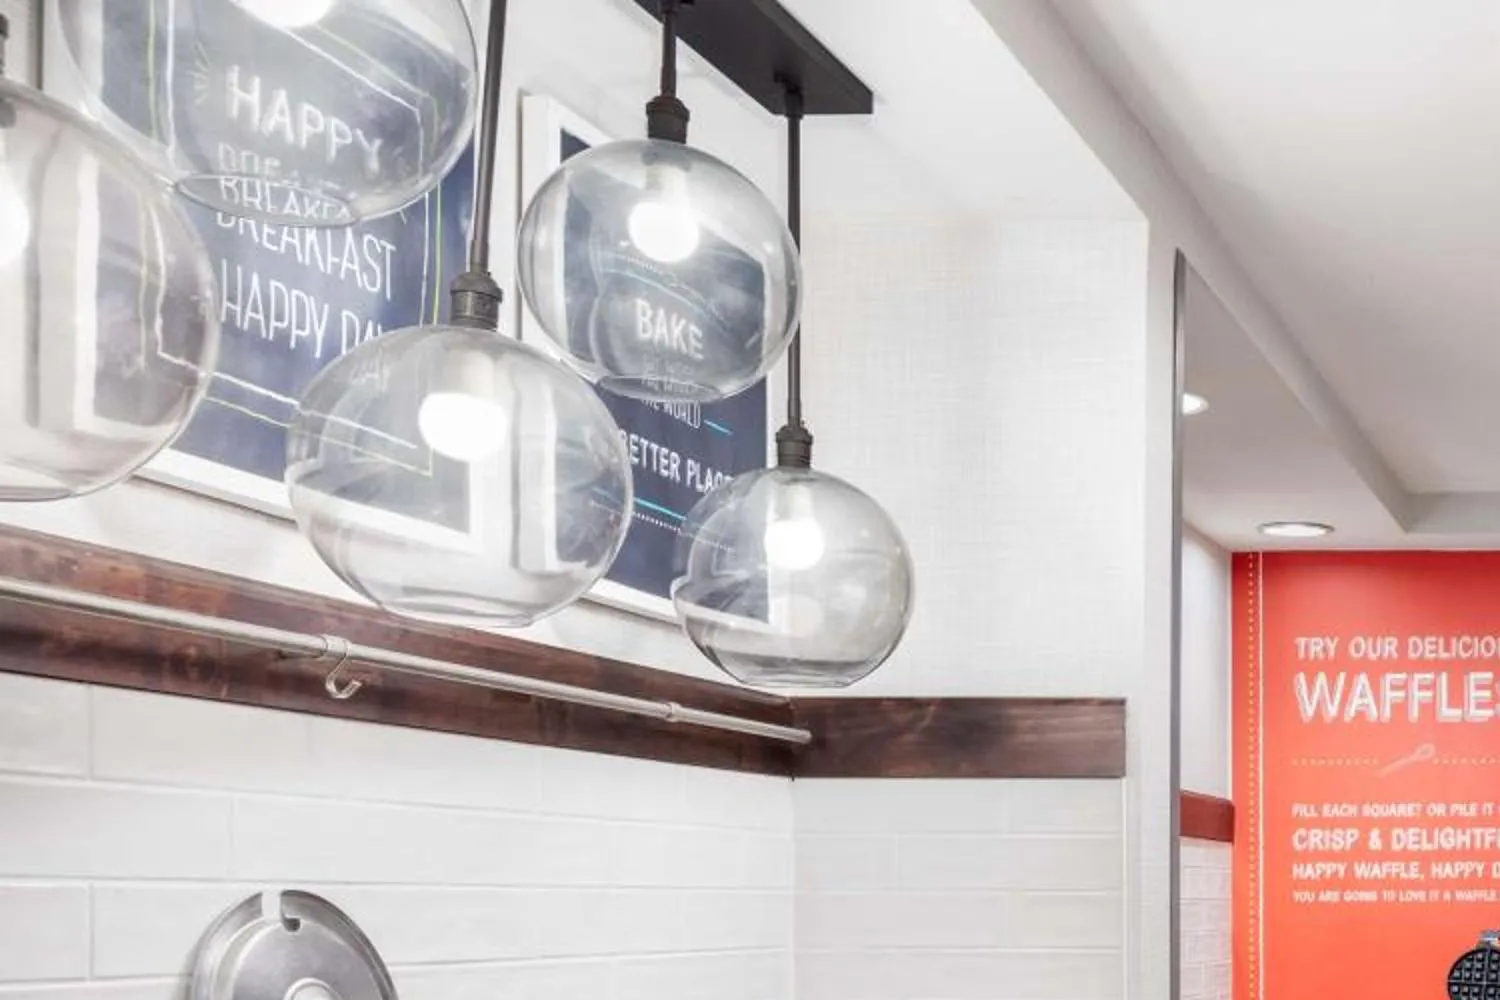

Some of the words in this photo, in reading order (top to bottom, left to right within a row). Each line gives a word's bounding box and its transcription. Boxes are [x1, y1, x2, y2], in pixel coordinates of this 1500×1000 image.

[226, 64, 384, 174] HAPPY
[219, 258, 329, 358] HAPPY
[636, 298, 704, 359] BAKE
[686, 458, 734, 495] PLAC
[1295, 636, 1340, 661] TRY
[1349, 636, 1399, 661] OUR
[1292, 827, 1360, 851] CRISP
[1368, 827, 1382, 851] &
[1292, 861, 1347, 880] HAPPY
[1431, 861, 1485, 880] HAPPY
